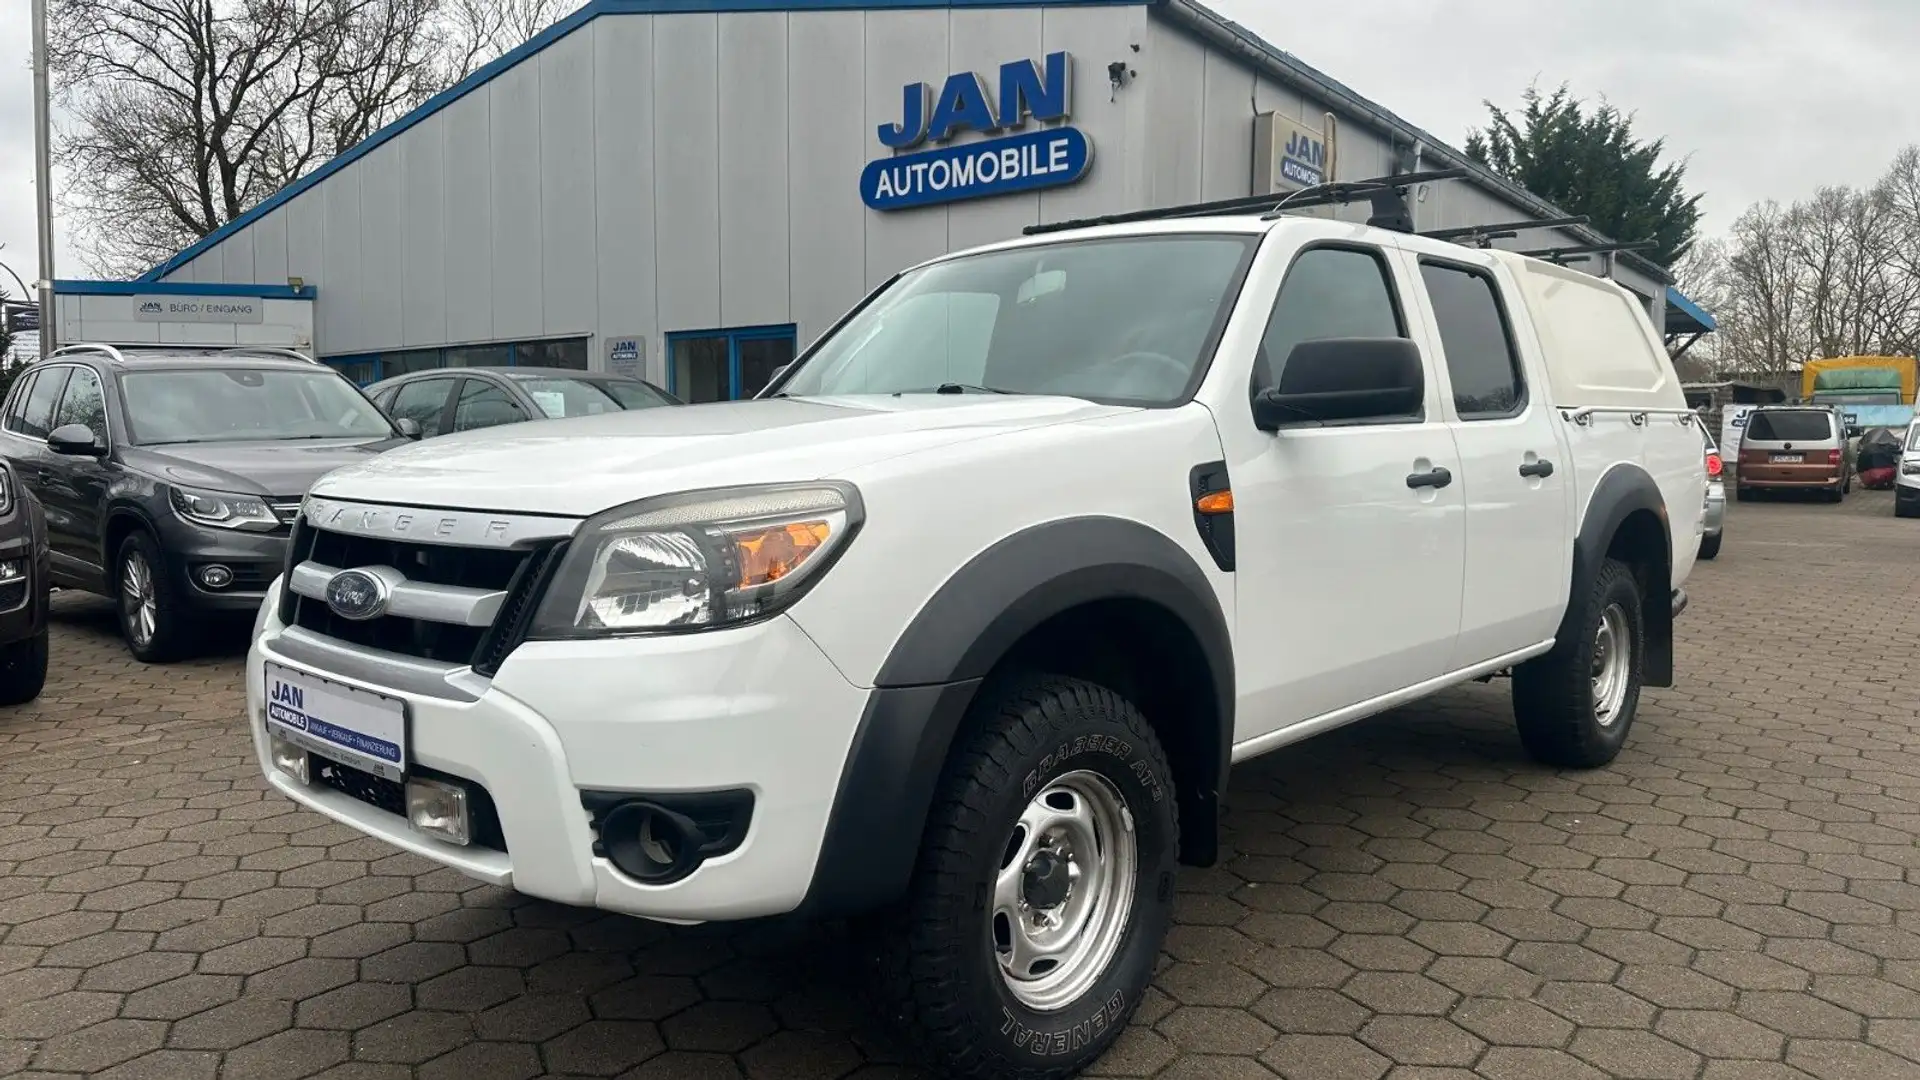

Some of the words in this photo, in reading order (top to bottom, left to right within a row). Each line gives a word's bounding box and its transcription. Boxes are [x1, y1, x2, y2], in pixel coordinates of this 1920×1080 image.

[877, 50, 1072, 149] JAN
[1285, 130, 1324, 168] JAN
[874, 138, 1069, 200] AUTOMOBILE
[169, 303, 198, 313] BÜRO
[206, 304, 253, 314] EINGANG
[613, 341, 636, 351] JAN
[311, 504, 510, 540] RANGER
[335, 576, 371, 606] Ford
[271, 680, 304, 709] JAN
[271, 706, 304, 727] AUTOMOBILE
[1023, 734, 1132, 797] GRABBER
[1000, 988, 1125, 1056] GENERAL
